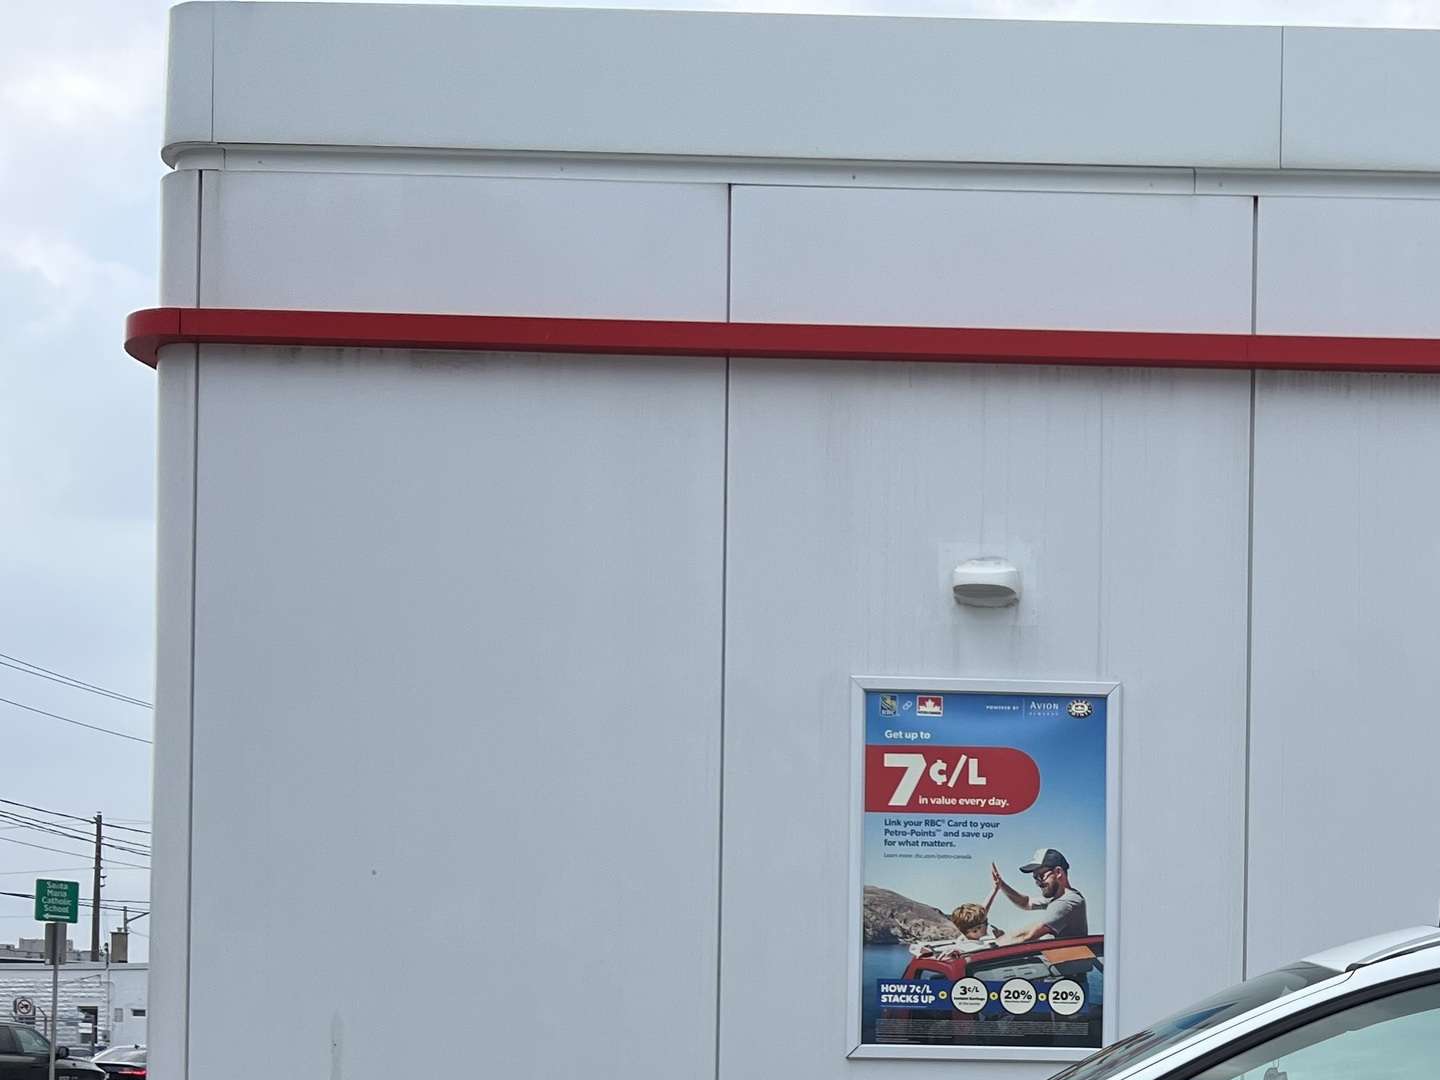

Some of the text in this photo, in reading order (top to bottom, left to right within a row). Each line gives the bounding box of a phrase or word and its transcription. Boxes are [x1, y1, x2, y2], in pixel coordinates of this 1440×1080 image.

[884, 730, 931, 741] Get up to
[918, 795, 1010, 808] in value every day.
[884, 819, 902, 827] Link
[903, 820, 922, 828] your
[947, 820, 968, 828] Card
[943, 830, 960, 838] and
[961, 831, 981, 839] save
[982, 832, 994, 840] up
[884, 839, 957, 848] for what matters.
[44, 904, 70, 914] School
[880, 984, 908, 993] HOW
[880, 994, 936, 1004] STACKS UP
[1003, 990, 1033, 1000] 20%
[1052, 991, 1081, 1001] 20%
